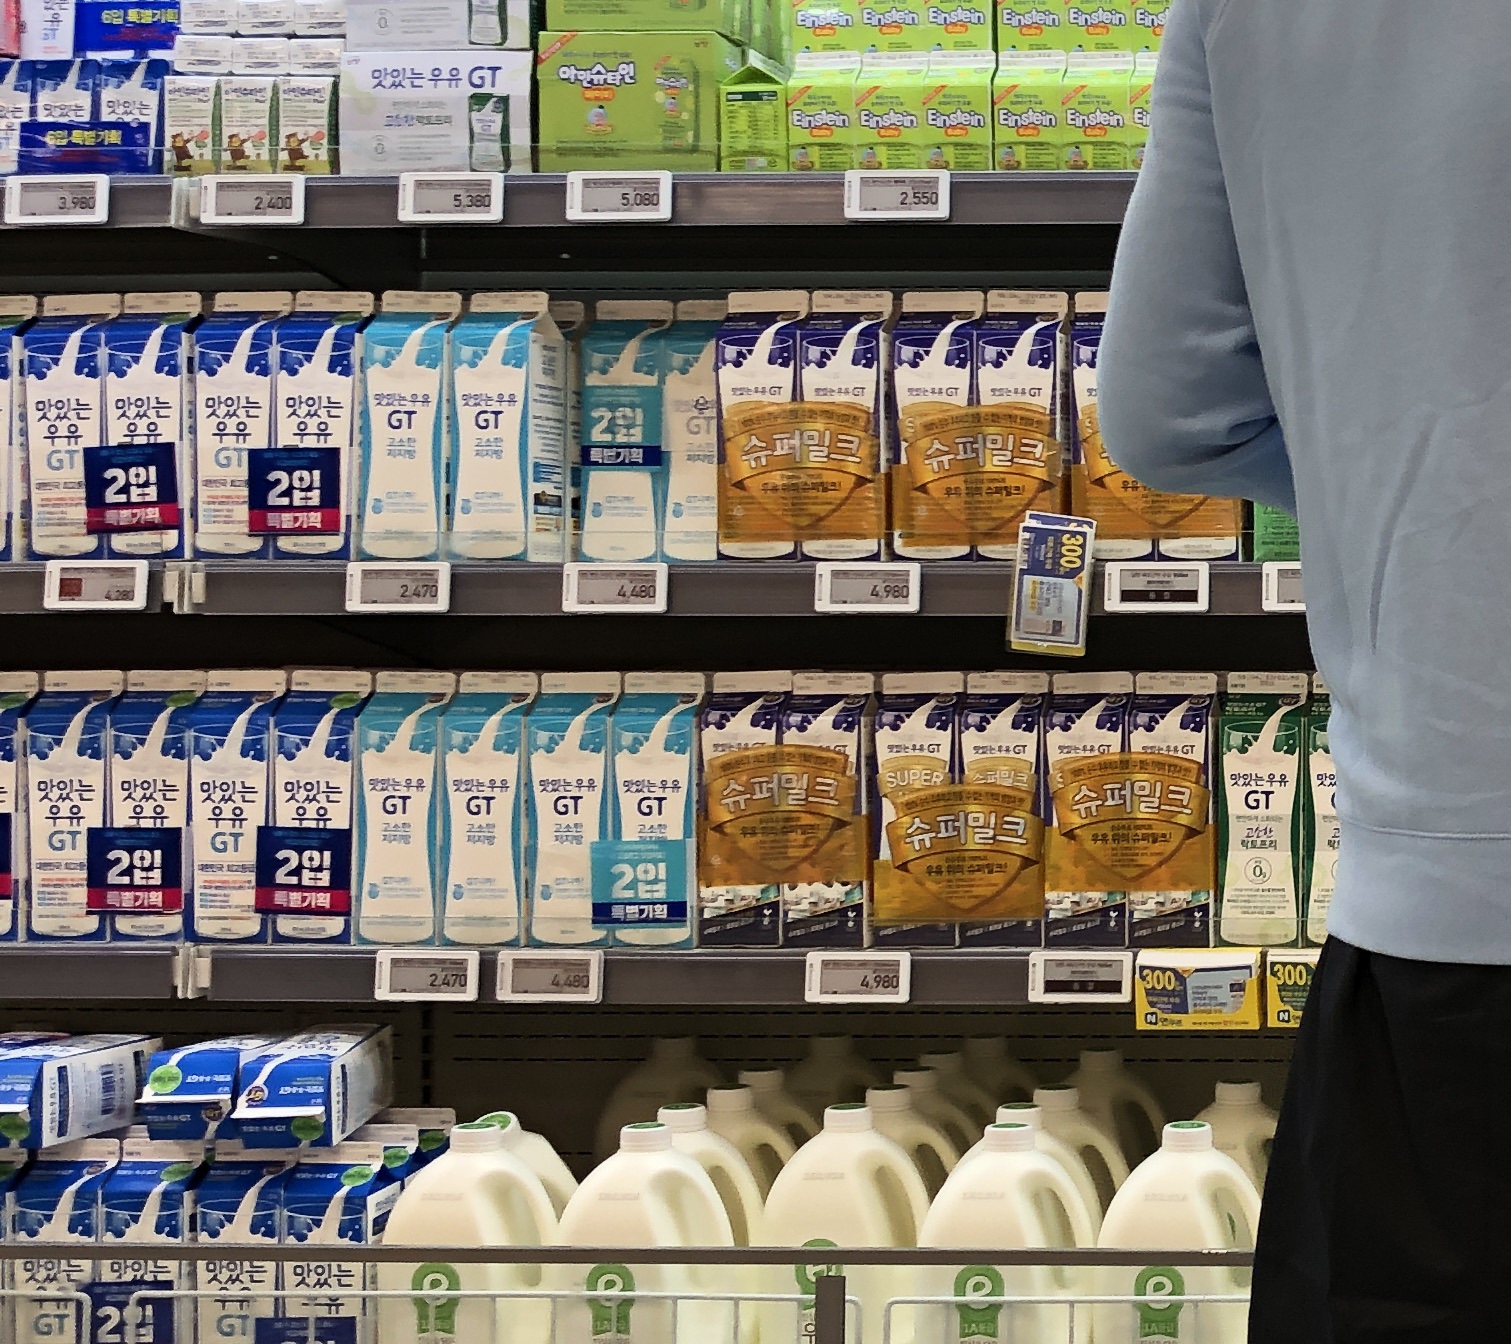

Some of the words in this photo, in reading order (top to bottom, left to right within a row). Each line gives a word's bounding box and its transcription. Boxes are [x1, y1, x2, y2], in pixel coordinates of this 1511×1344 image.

[796, 8, 853, 28] Einstein
[863, 6, 918, 26] Einstein
[928, 6, 984, 26] Einstein
[1002, 7, 1059, 27] Einstein
[1069, 7, 1125, 26] Einstein
[468, 66, 502, 88] GT
[792, 109, 849, 128] Einstein
[860, 109, 917, 128] Einstein
[927, 109, 984, 128] Einstein
[1000, 109, 1056, 128] Einstein
[1066, 109, 1123, 129] Einstein
[35, 397, 92, 422] 맛있는
[115, 397, 172, 420] 맛있는
[205, 396, 262, 419] 맛있는
[285, 396, 344, 419] 맛있는
[388, 411, 417, 430] GT
[475, 411, 504, 430] GT
[43, 423, 83, 446] 우유
[123, 422, 163, 444] 우유
[212, 421, 251, 445] 우유
[293, 420, 333, 444] 우유
[214, 447, 248, 469] GT
[742, 428, 862, 467] 슈퍼밀크
[924, 433, 1045, 472] 슈퍼밀크
[46, 449, 80, 471] GT
[103, 466, 157, 504] 2입
[266, 469, 321, 507] 2입
[886, 770, 943, 787] SUPER
[37, 779, 96, 803] 맛있는
[121, 779, 180, 803] 맛있는
[200, 780, 258, 804] 맛있는
[284, 781, 343, 804] 맛있는
[720, 773, 839, 812] 슈퍼밀크
[1072, 781, 1193, 817] 슈퍼밀크
[1244, 790, 1275, 810] GT
[45, 805, 86, 827] 우유
[128, 805, 170, 827] 우유
[382, 796, 411, 815] GT
[466, 796, 496, 815] GT
[553, 796, 583, 815] GT
[637, 796, 668, 816] GT
[208, 806, 248, 828] 우유
[291, 806, 332, 828] 우유
[48, 830, 82, 852] GT
[905, 811, 1027, 851] 슈퍼밀크
[211, 832, 245, 854] GT
[106, 849, 163, 886] 2입
[274, 849, 331, 887] 2입
[610, 862, 667, 899] 2입
[1142, 969, 1174, 990] 300
[1274, 965, 1307, 986] 300
[293, 1264, 355, 1288] 맛있는
[216, 1314, 250, 1336] GT
